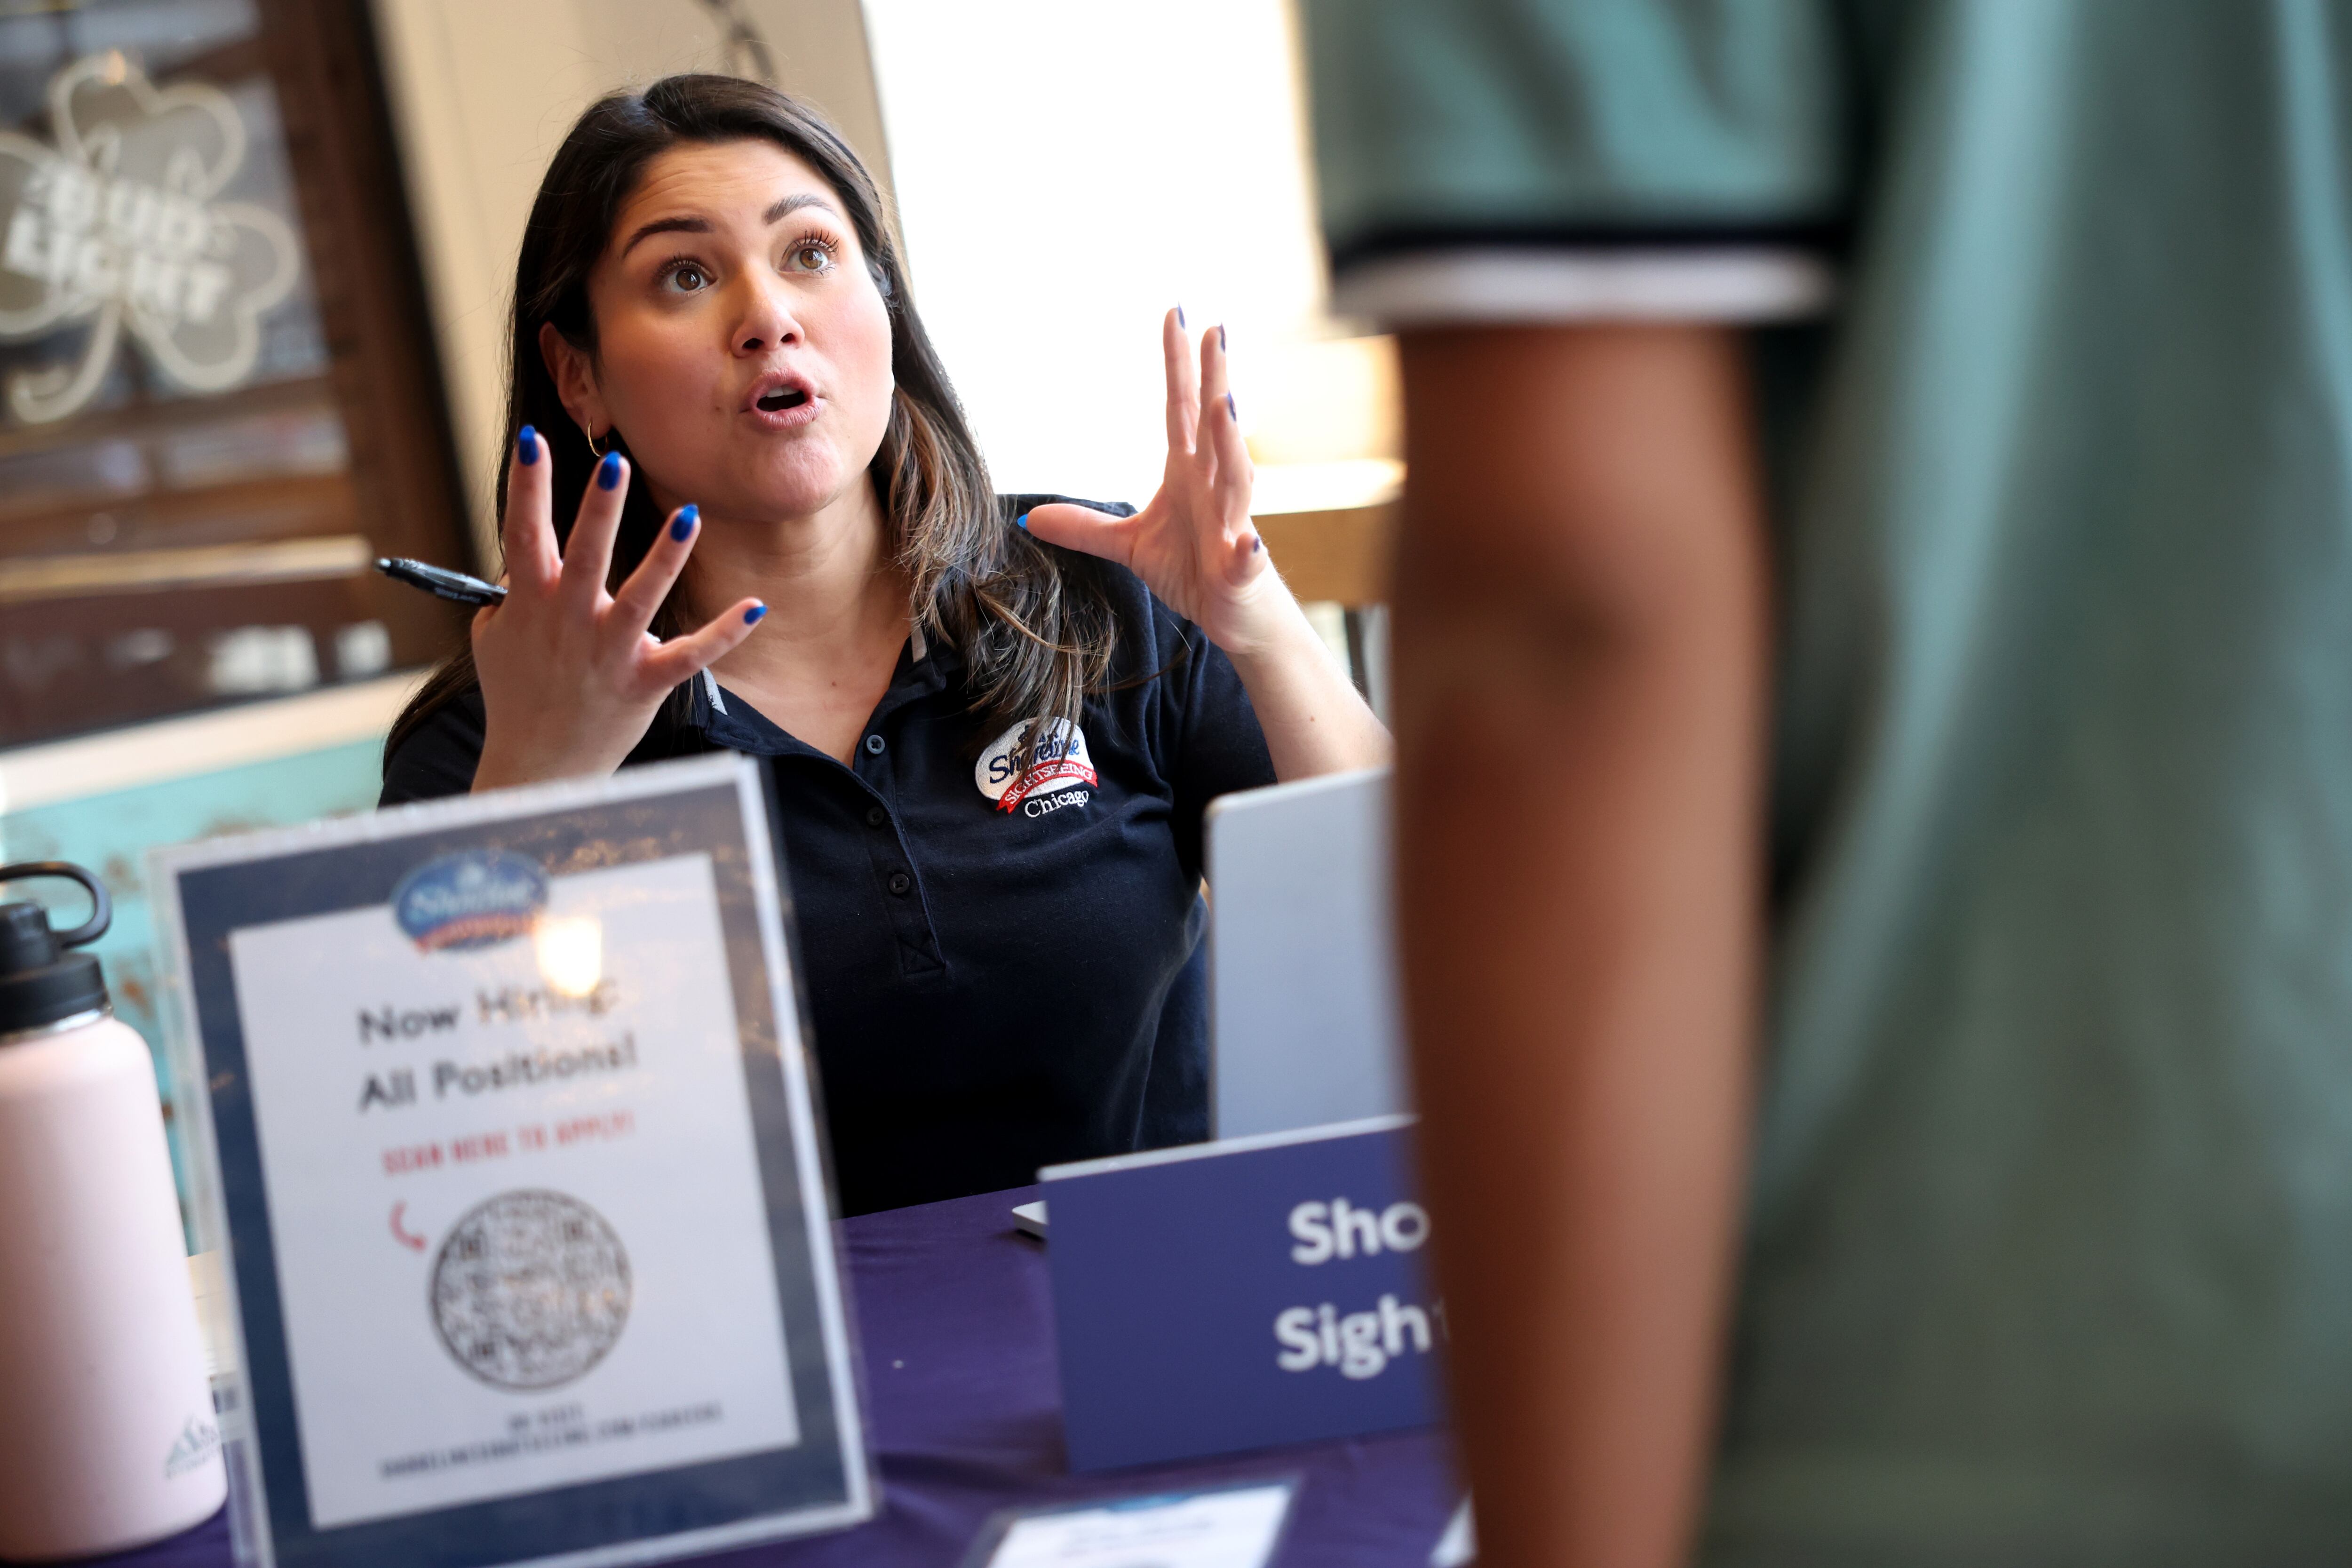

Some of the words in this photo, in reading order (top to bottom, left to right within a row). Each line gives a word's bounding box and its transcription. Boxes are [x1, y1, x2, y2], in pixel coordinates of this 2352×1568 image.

[49, 162, 206, 255] BUD
[7, 205, 231, 323] LIGHT
[989, 733, 1080, 784] Shreline
[1024, 790, 1089, 818] Chicago
[358, 1003, 460, 1045] Now
[358, 1066, 417, 1115] All
[450, 1131, 508, 1163] HERE
[519, 1124, 547, 1152] TO
[1274, 1293, 1449, 1380] Sigh
